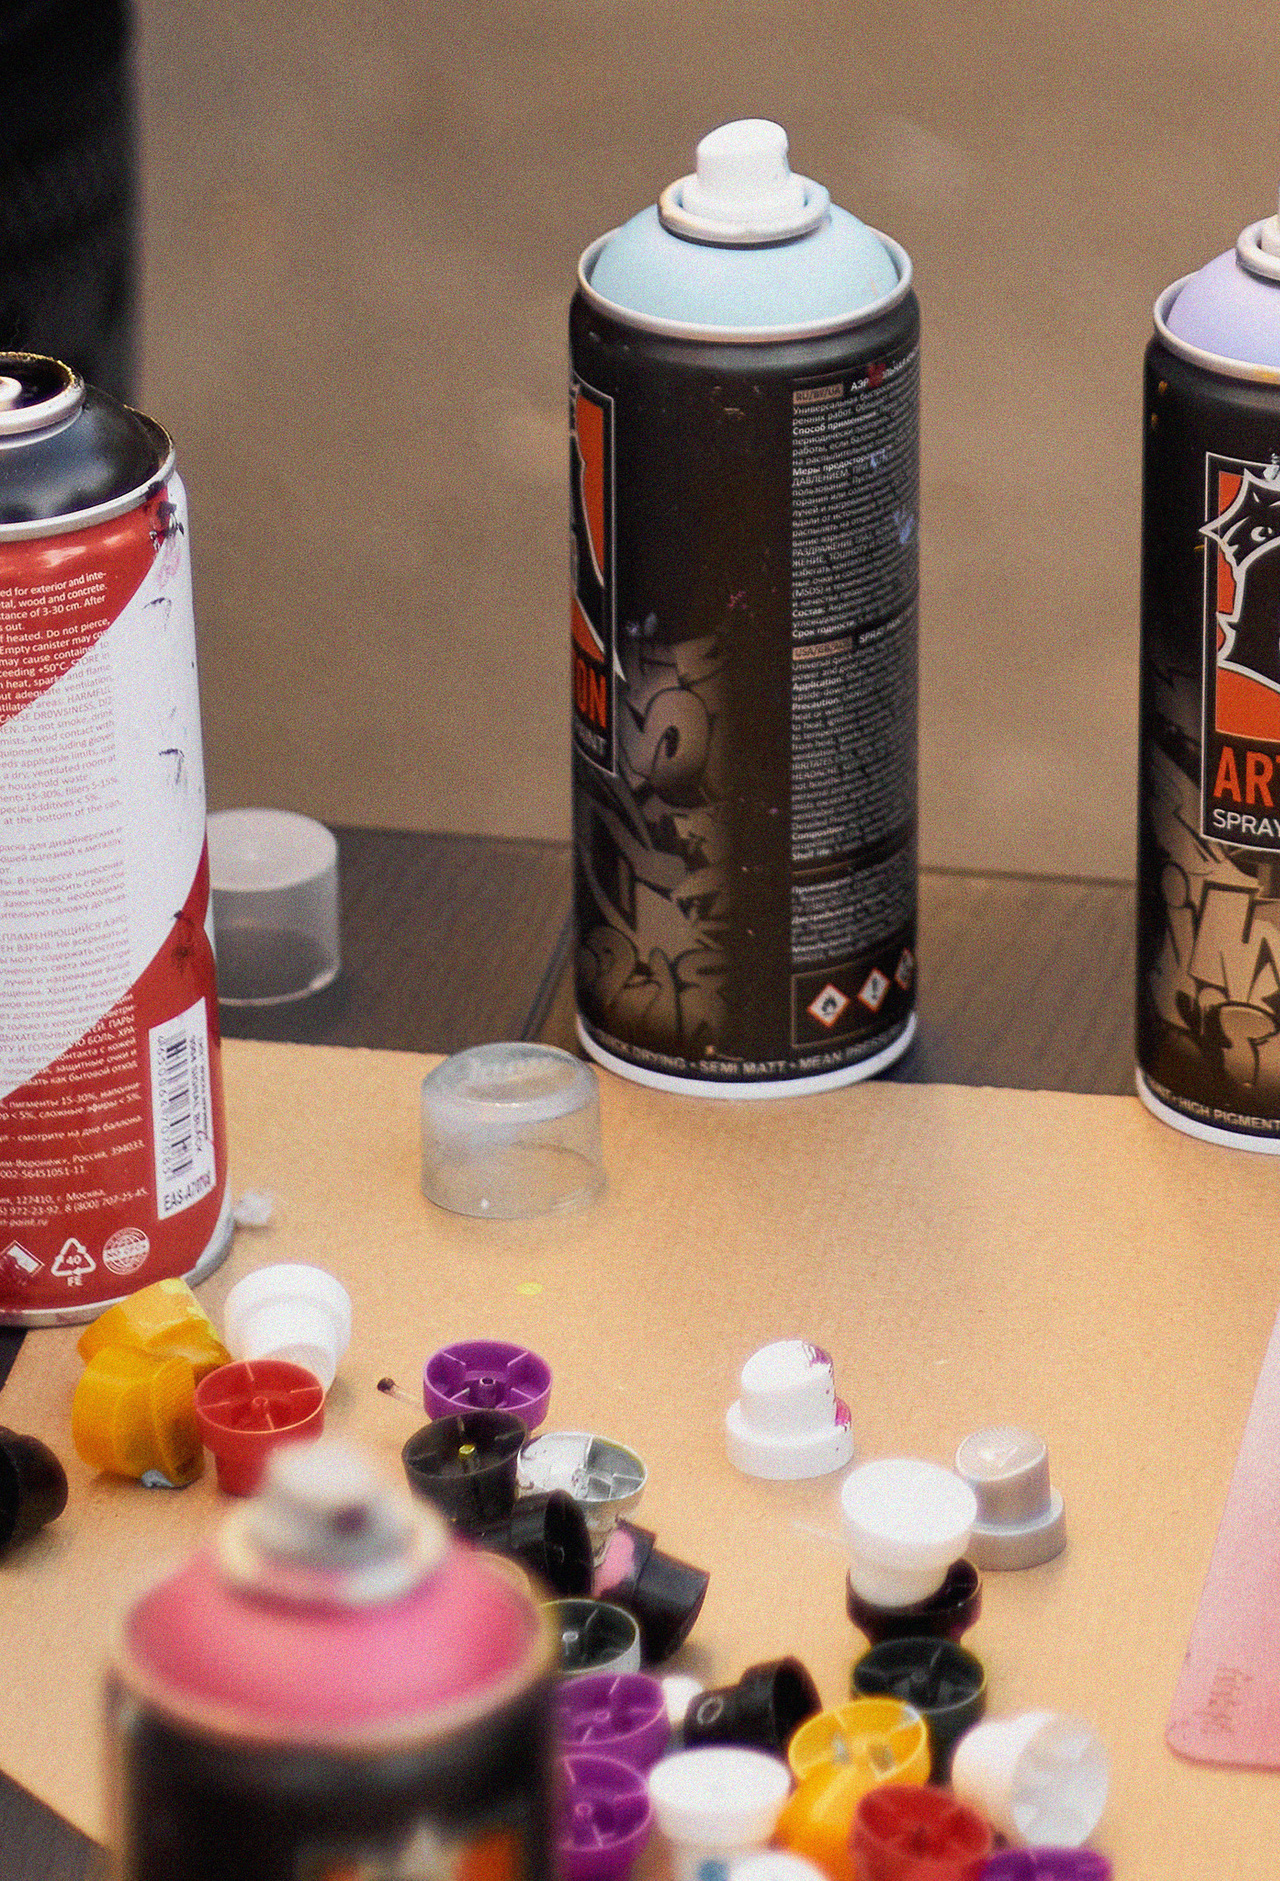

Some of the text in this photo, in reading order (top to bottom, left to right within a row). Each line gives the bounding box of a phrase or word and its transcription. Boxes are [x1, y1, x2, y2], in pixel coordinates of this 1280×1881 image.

[14, 587, 28, 596] for
[30, 582, 67, 594] exterior
[69, 575, 85, 587] and
[19, 596, 46, 607] wood
[49, 592, 66, 604] and
[30, 607, 40, 618] of
[84, 595, 106, 607] After
[46, 629, 60, 639] Do
[63, 625, 78, 636] not
[32, 640, 69, 652] canister
[72, 635, 90, 647] may
[23, 654, 50, 665] cause
[700, 1061, 738, 1074] SEMI
[743, 1060, 787, 1074] MATT
